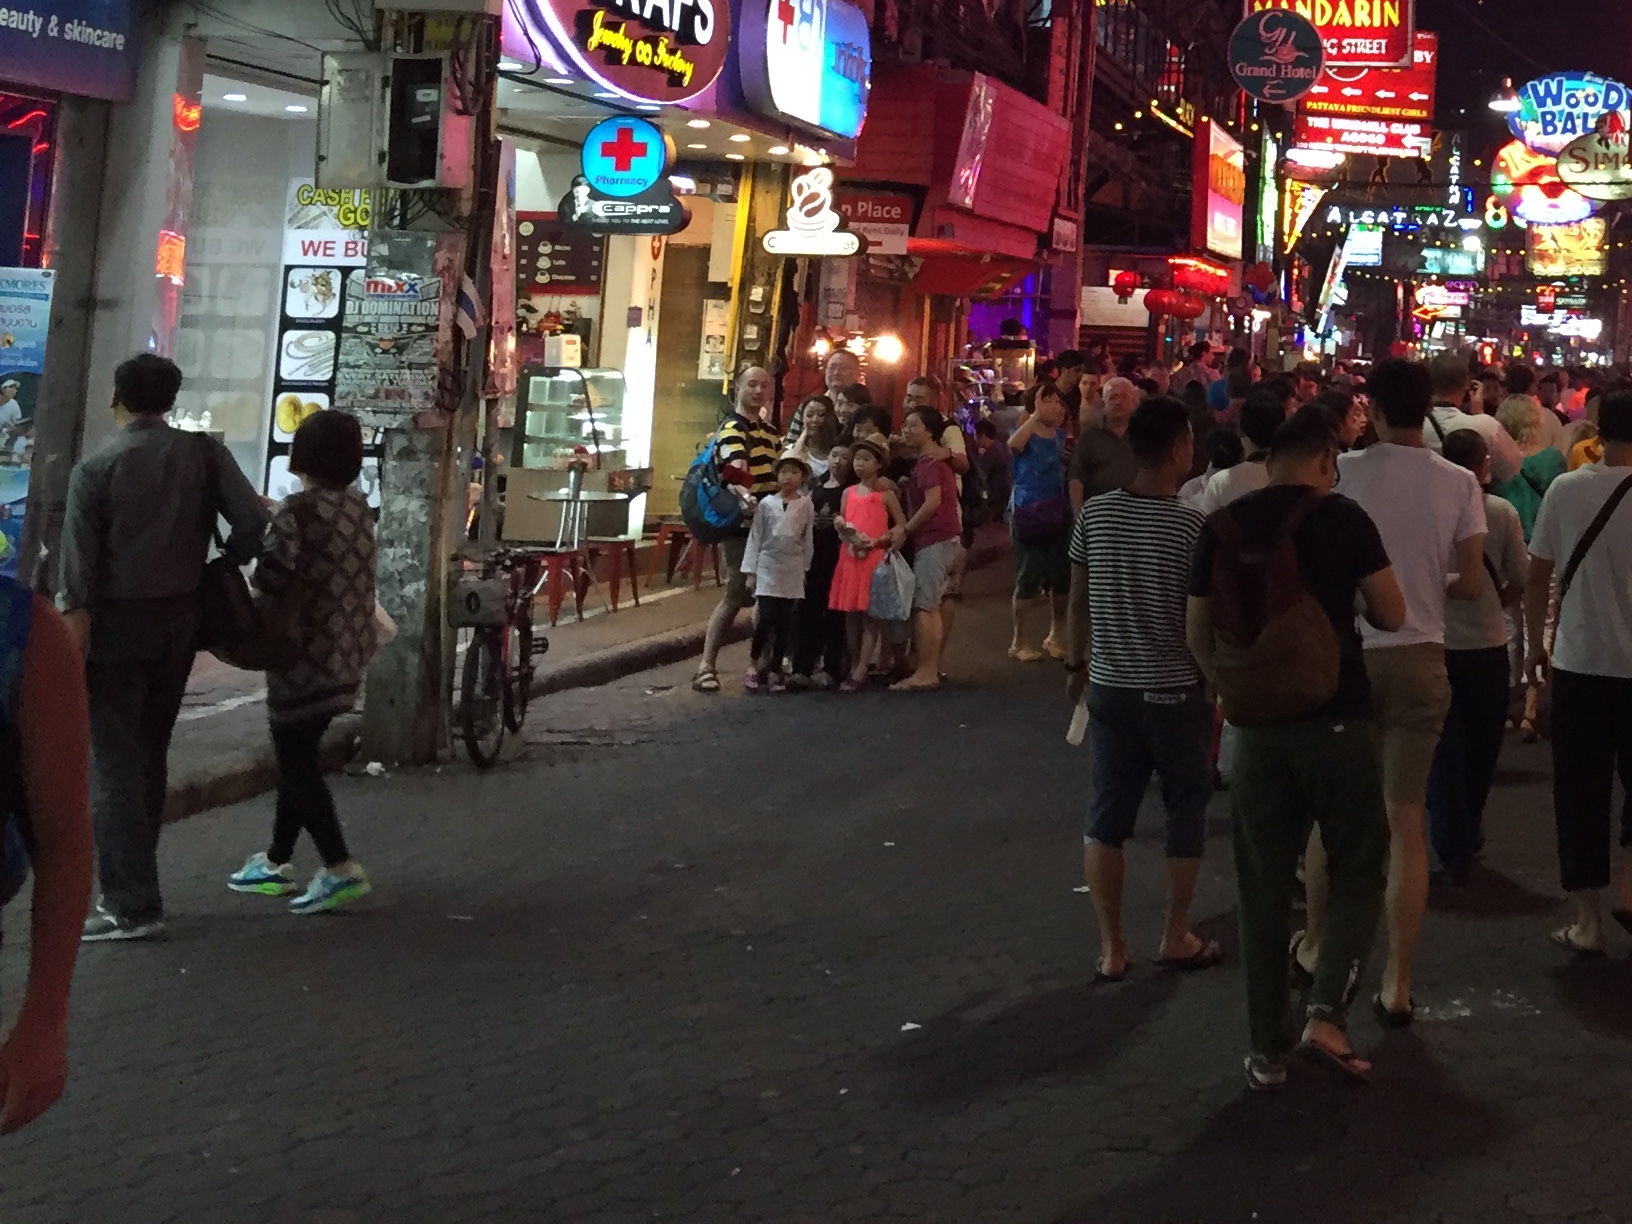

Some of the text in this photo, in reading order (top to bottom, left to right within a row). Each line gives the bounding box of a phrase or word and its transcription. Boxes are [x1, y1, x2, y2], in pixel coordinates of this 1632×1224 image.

[47, 14, 59, 37] &
[63, 18, 126, 51] skincare
[1341, 38, 1388, 55] STREET
[1235, 62, 1318, 79] Grand Hotel
[1306, 101, 1428, 118] PATTAYA FRIENDLIEST GIRLS
[595, 174, 650, 188] Pharmacy
[297, 183, 356, 207] CASH
[598, 202, 672, 215] cappra
[857, 200, 902, 218] Place
[1326, 205, 1458, 227] ALCATRAZ
[301, 239, 336, 258] WE
[361, 301, 440, 316] DOMINATION
